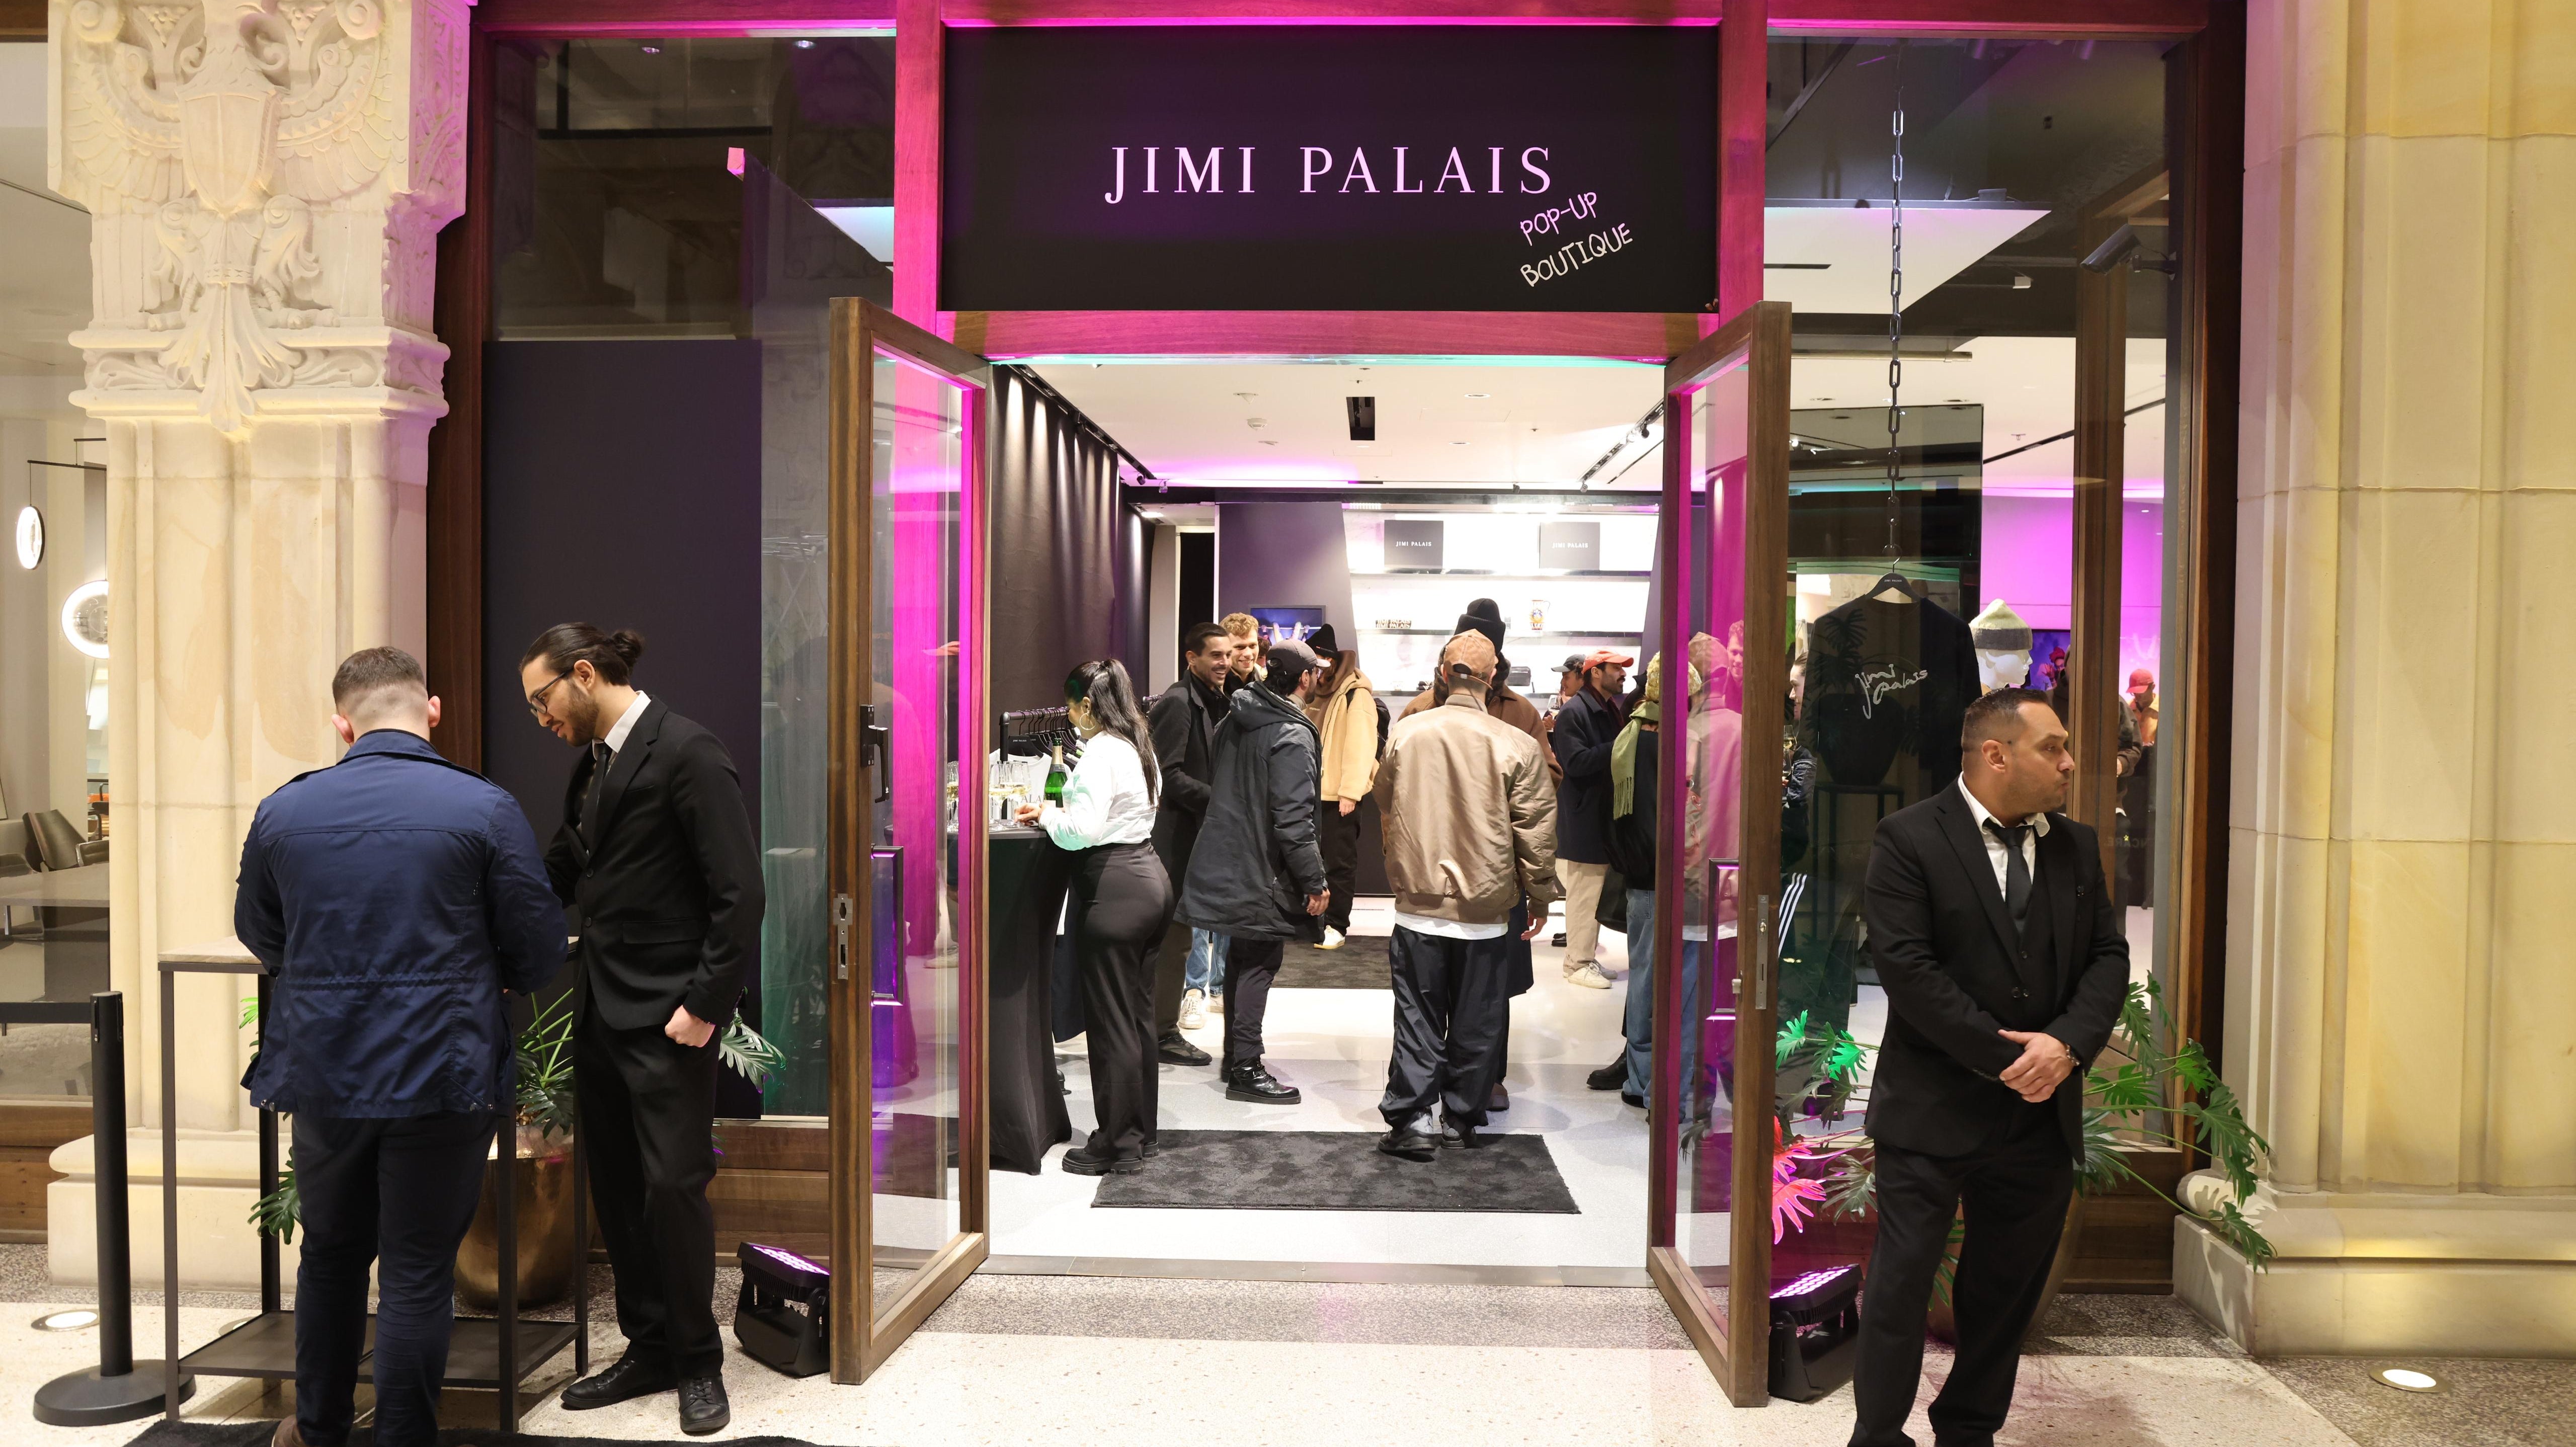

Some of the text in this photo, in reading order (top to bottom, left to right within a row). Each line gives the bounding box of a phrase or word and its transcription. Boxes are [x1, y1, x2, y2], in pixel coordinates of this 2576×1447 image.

[1104, 146, 1551, 204] JIMI PALAIS
[1520, 192, 1597, 246] POP-UP
[1520, 223, 1633, 287] BOUTIQUE
[1855, 663, 1896, 719] jimi
[1873, 669, 1928, 705] palais
